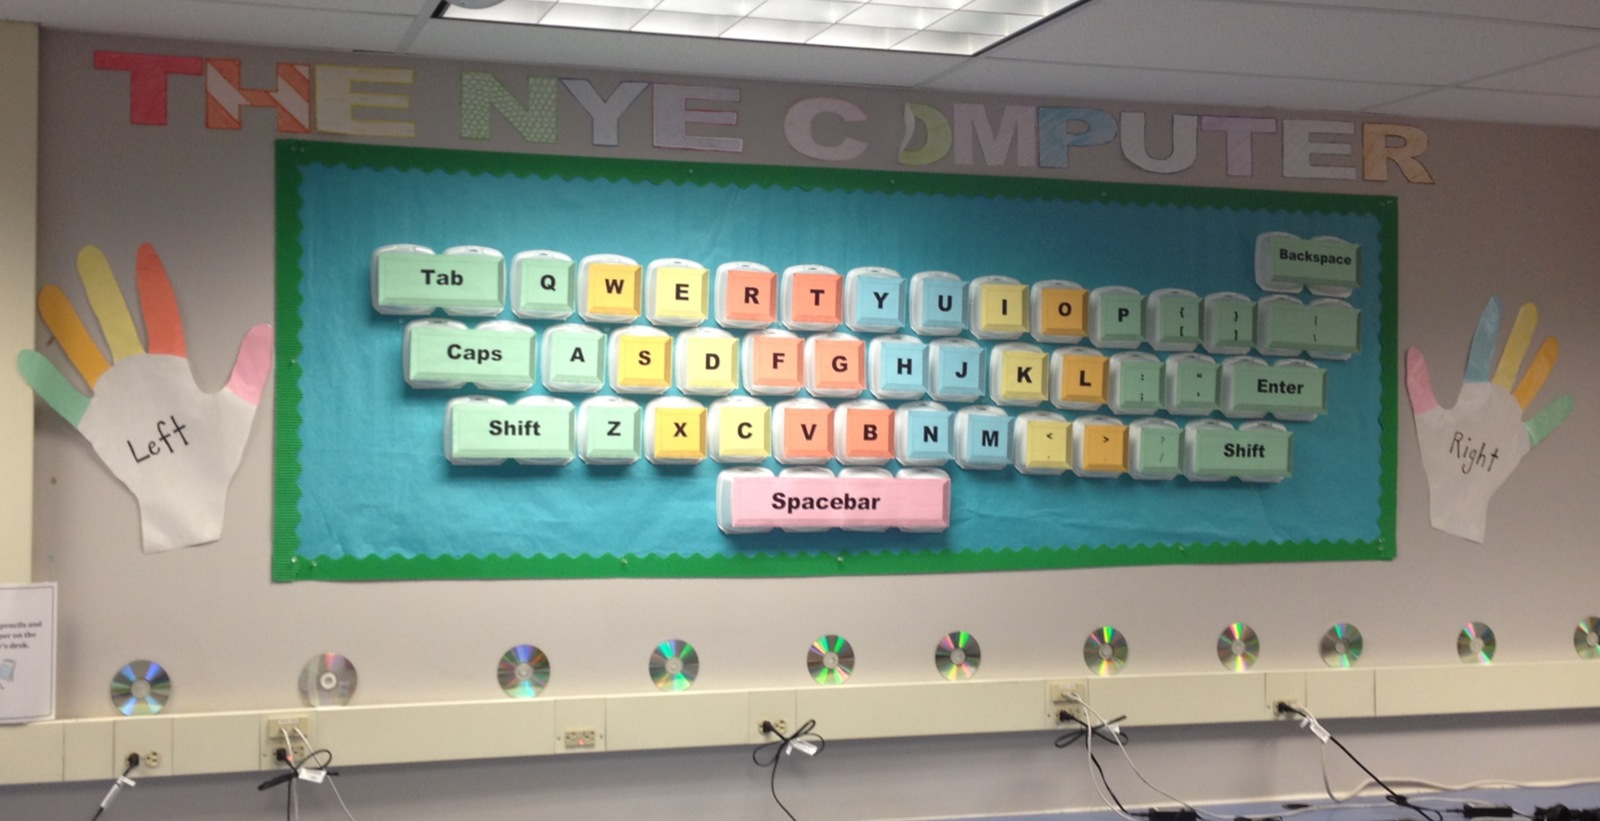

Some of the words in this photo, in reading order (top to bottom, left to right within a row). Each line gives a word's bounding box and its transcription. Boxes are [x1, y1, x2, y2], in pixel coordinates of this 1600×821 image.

[93, 51, 416, 137] THE
[459, 70, 743, 152] NYE
[1279, 248, 1352, 266] Backspace
[420, 269, 464, 286] Tab
[540, 274, 556, 292] Q
[604, 278, 625, 295] W
[675, 283, 690, 301] E
[744, 286, 759, 305] R
[809, 288, 825, 306] T
[873, 291, 889, 309] Y
[938, 294, 953, 312] U
[1001, 299, 1008, 316] I
[1058, 302, 1072, 317] O
[1118, 307, 1130, 323] P
[446, 343, 503, 365] Caps
[570, 346, 585, 363] A
[638, 350, 652, 366] S
[705, 353, 720, 370] D
[772, 352, 785, 370] F
[831, 355, 848, 373] G
[897, 357, 913, 375] H
[955, 361, 968, 379] J
[1017, 366, 1032, 384] K
[1079, 370, 1092, 387] L
[1257, 378, 1304, 395] Enter
[488, 420, 541, 436] Shift
[606, 420, 621, 437] Z
[673, 422, 687, 438] X
[737, 422, 753, 440] C
[800, 423, 817, 441] V
[863, 424, 878, 441] B
[923, 425, 938, 443] N
[126, 415, 189, 463] Left
[981, 430, 999, 448] M
[1223, 443, 1266, 458] Shift
[1449, 431, 1499, 475] Right
[771, 492, 881, 514] Spacebar
